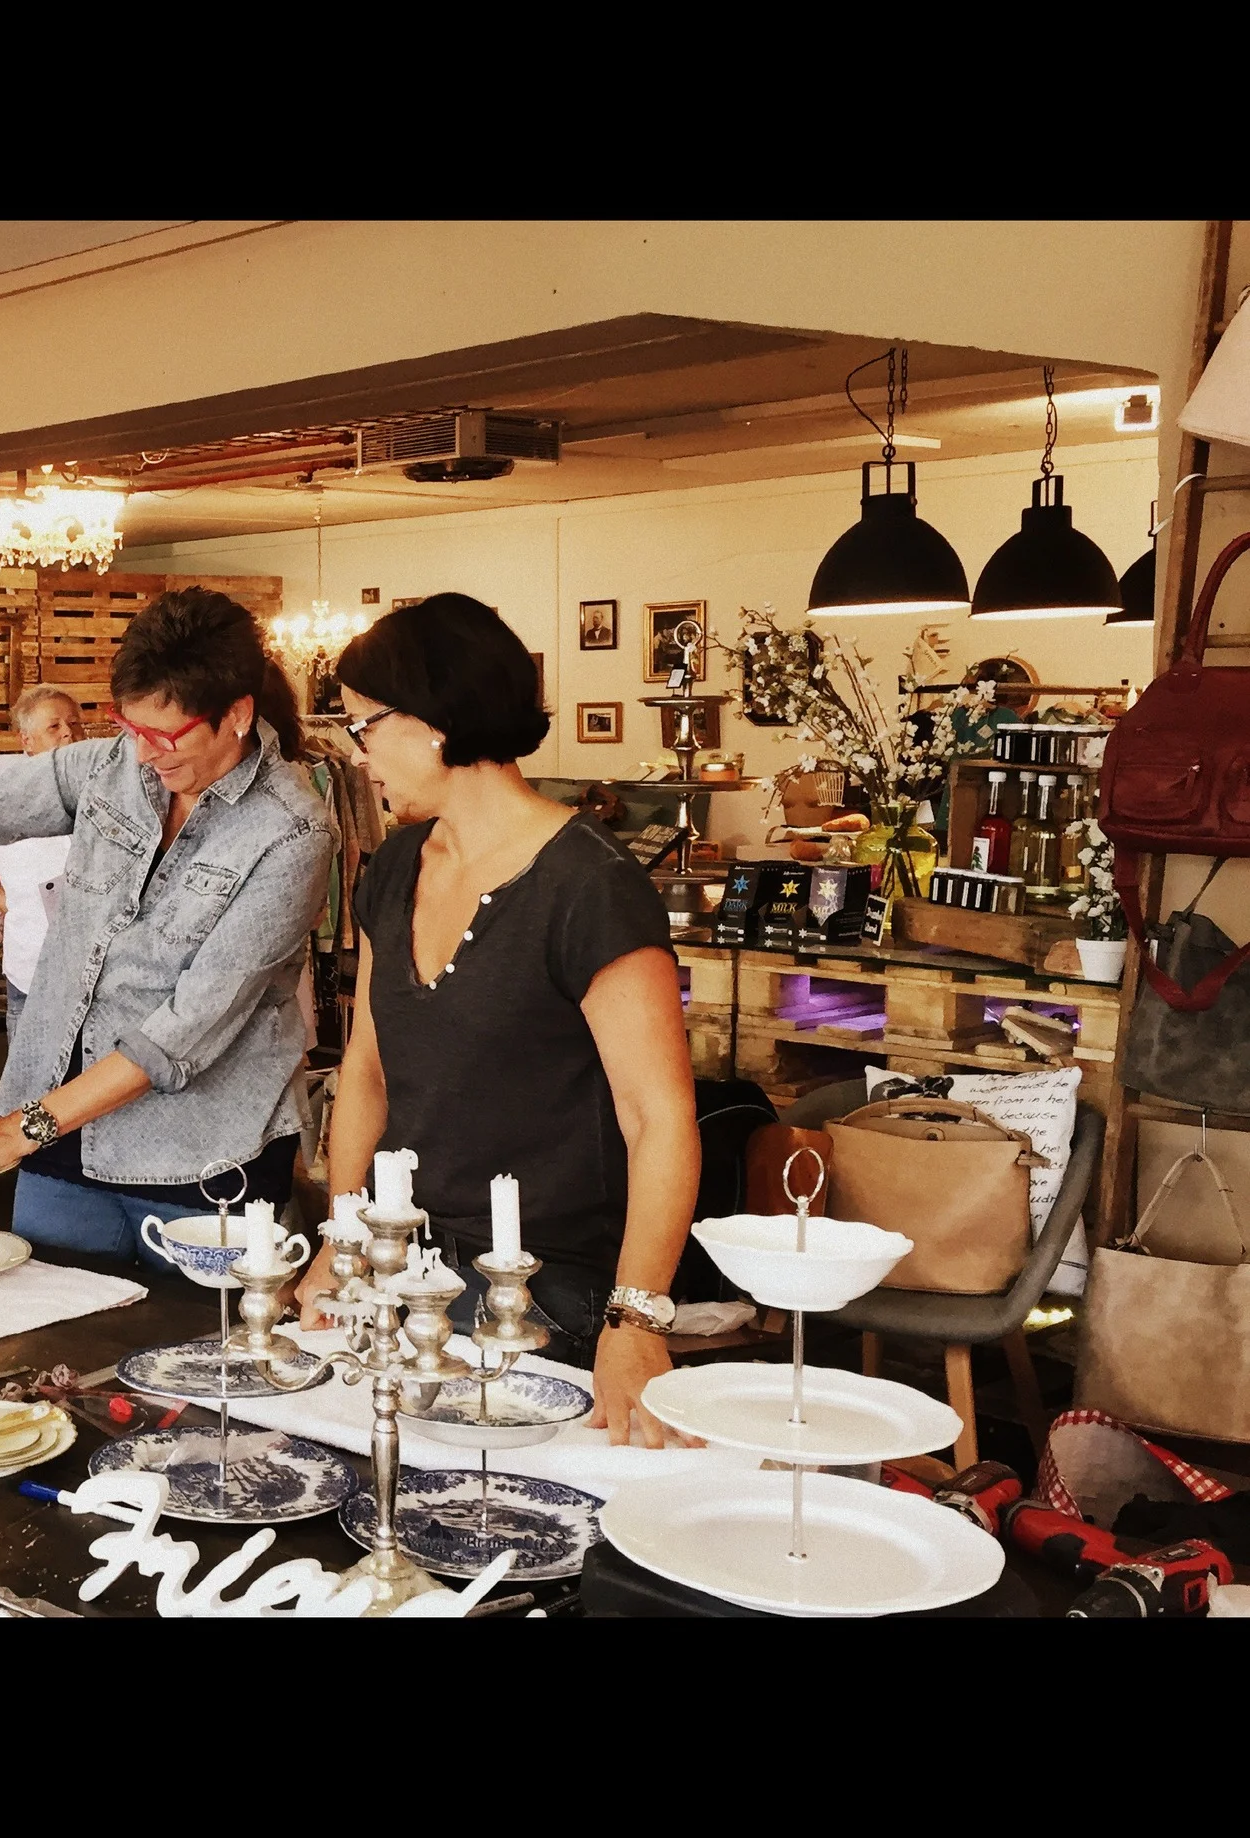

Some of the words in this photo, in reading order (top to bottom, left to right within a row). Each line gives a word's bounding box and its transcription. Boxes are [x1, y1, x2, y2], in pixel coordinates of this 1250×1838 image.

[771, 902, 798, 913] MILK
[1012, 1081, 1048, 1091] must
[1052, 1078, 1069, 1088] be
[994, 1096, 1024, 1108] from
[1045, 1094, 1068, 1105] her
[1000, 1110, 1058, 1120] because
[1022, 1126, 1047, 1137] the
